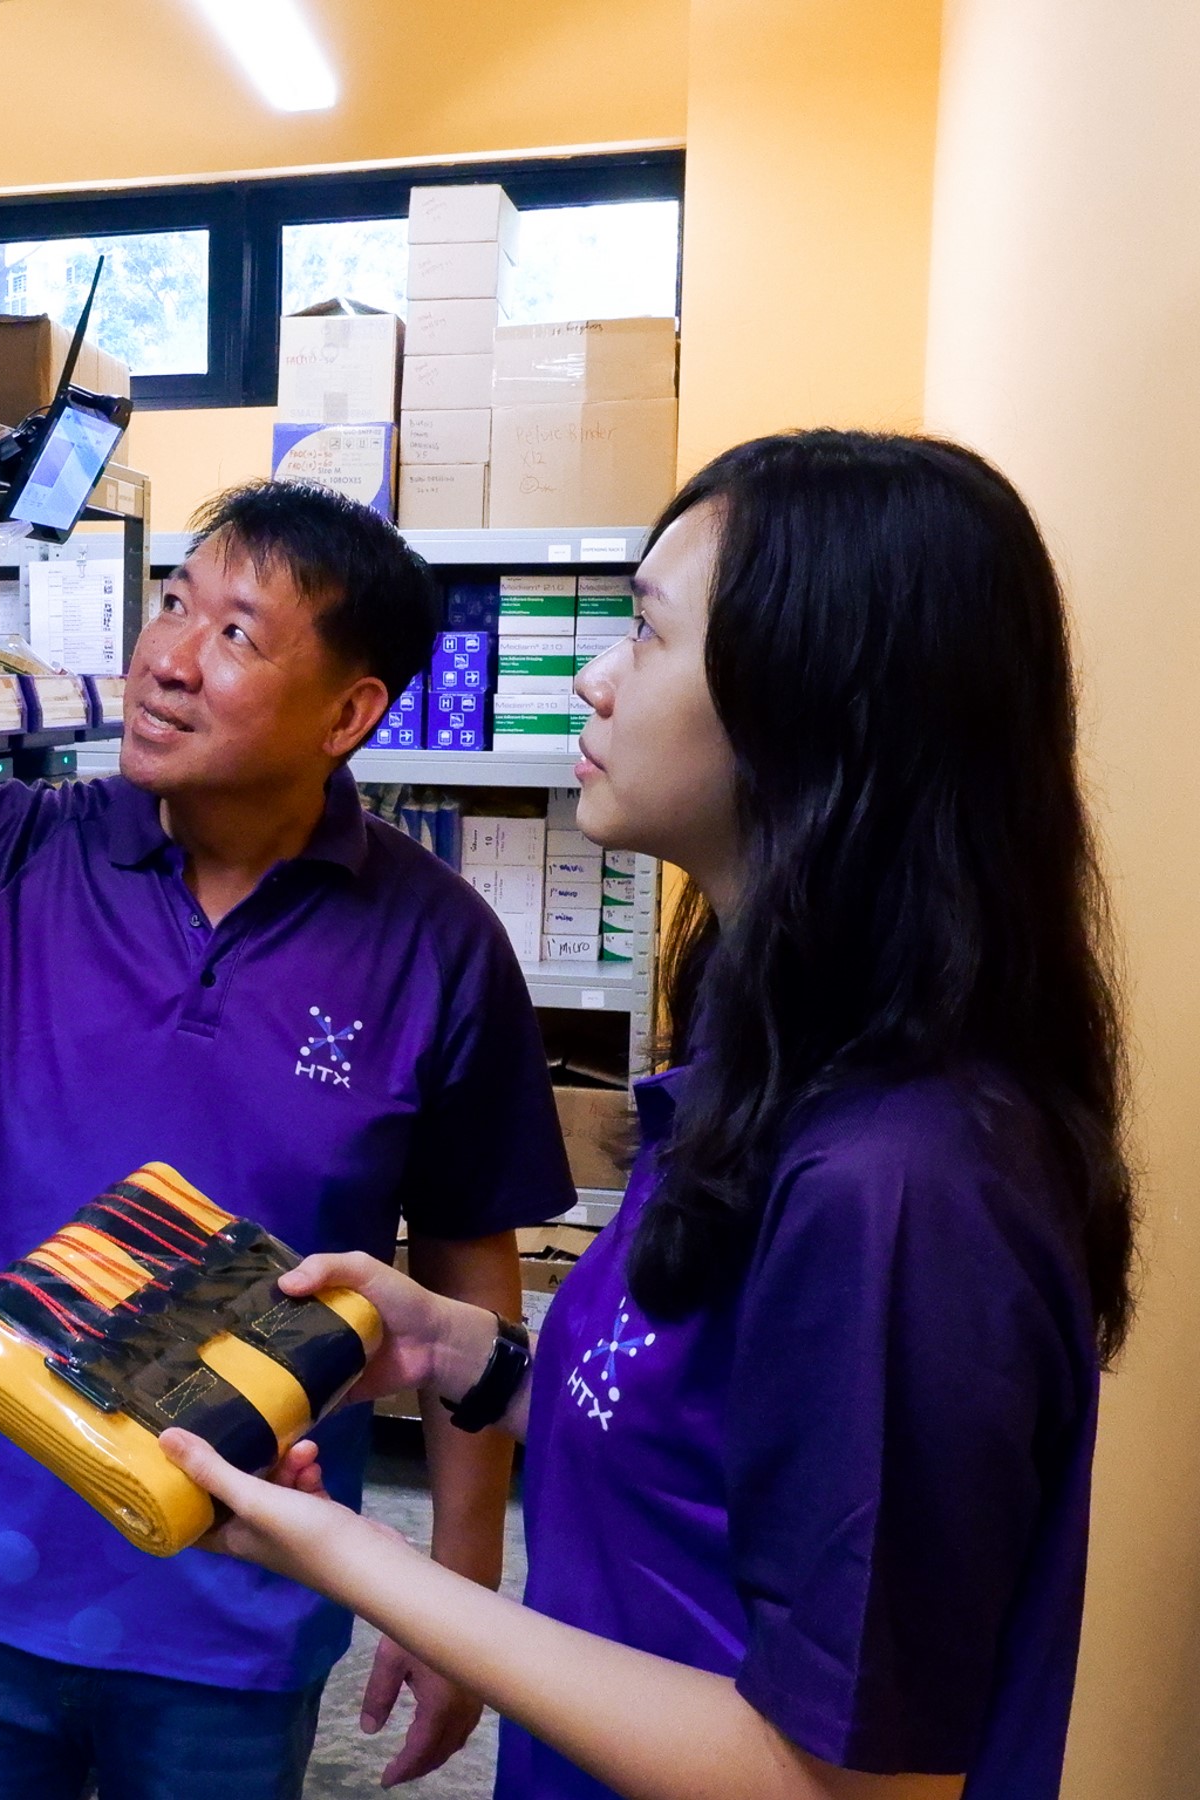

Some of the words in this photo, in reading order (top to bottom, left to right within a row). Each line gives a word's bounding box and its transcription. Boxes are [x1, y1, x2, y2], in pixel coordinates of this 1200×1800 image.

[543, 584, 565, 592] 210
[294, 1060, 350, 1089] HTX
[567, 1366, 613, 1431] HTX
